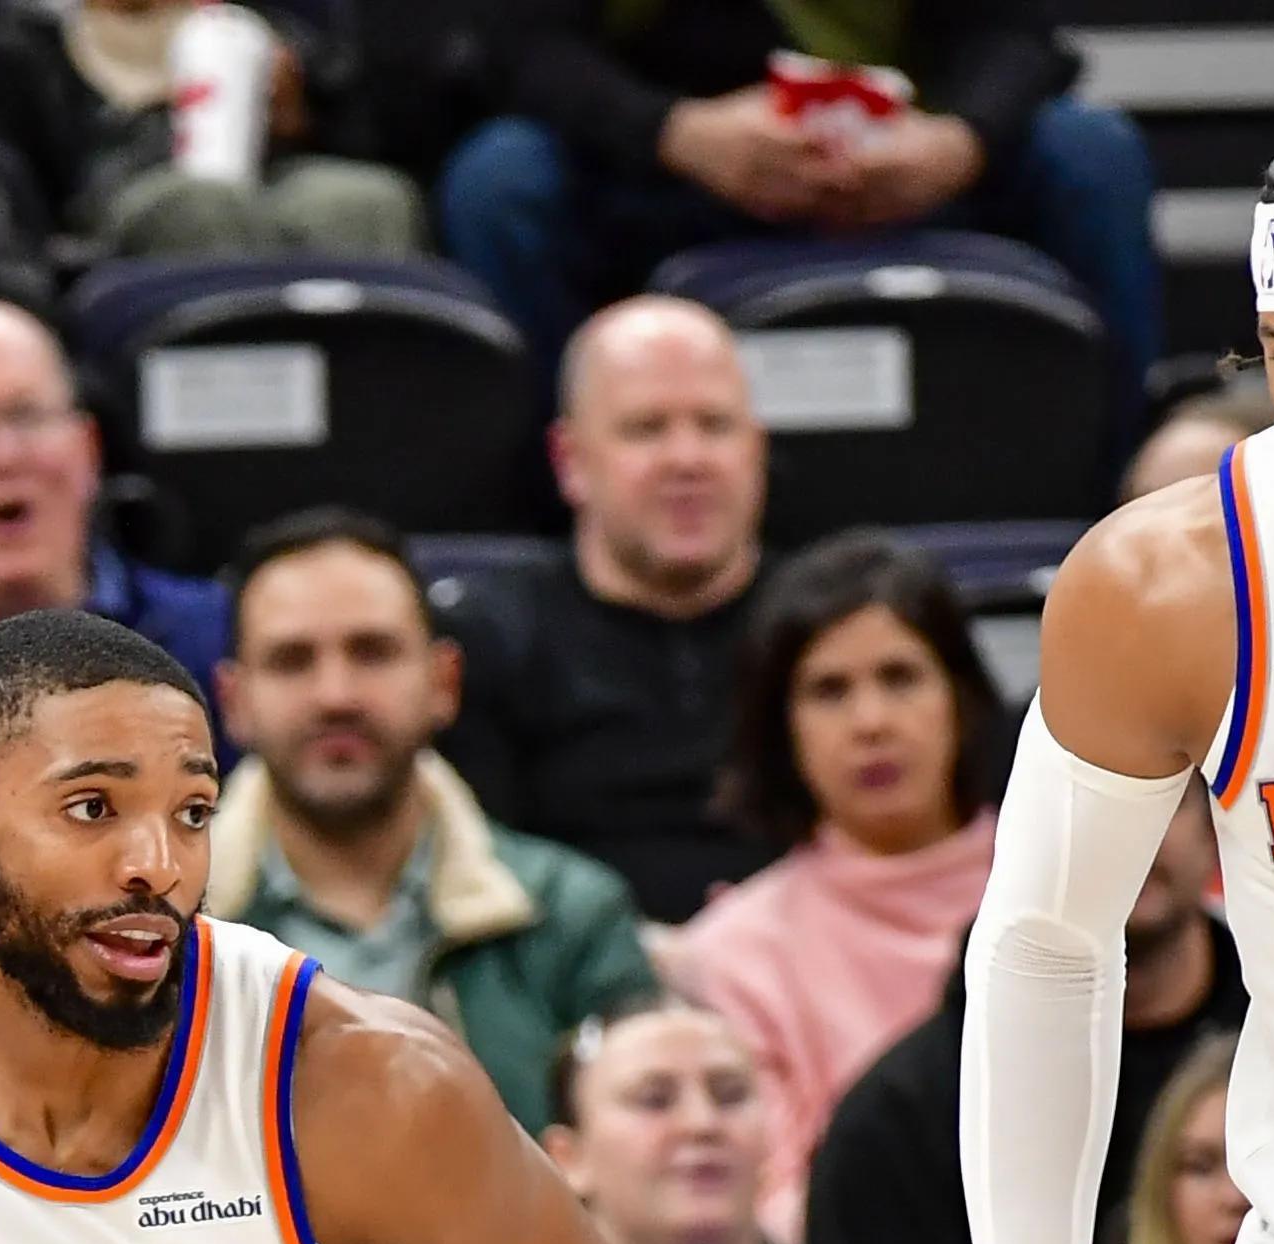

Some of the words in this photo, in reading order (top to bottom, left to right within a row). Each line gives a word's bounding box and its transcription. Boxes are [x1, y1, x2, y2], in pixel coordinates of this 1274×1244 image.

[139, 1191, 204, 1206] experience
[138, 1207, 186, 1228] abu
[190, 1195, 262, 1223] dhabi
